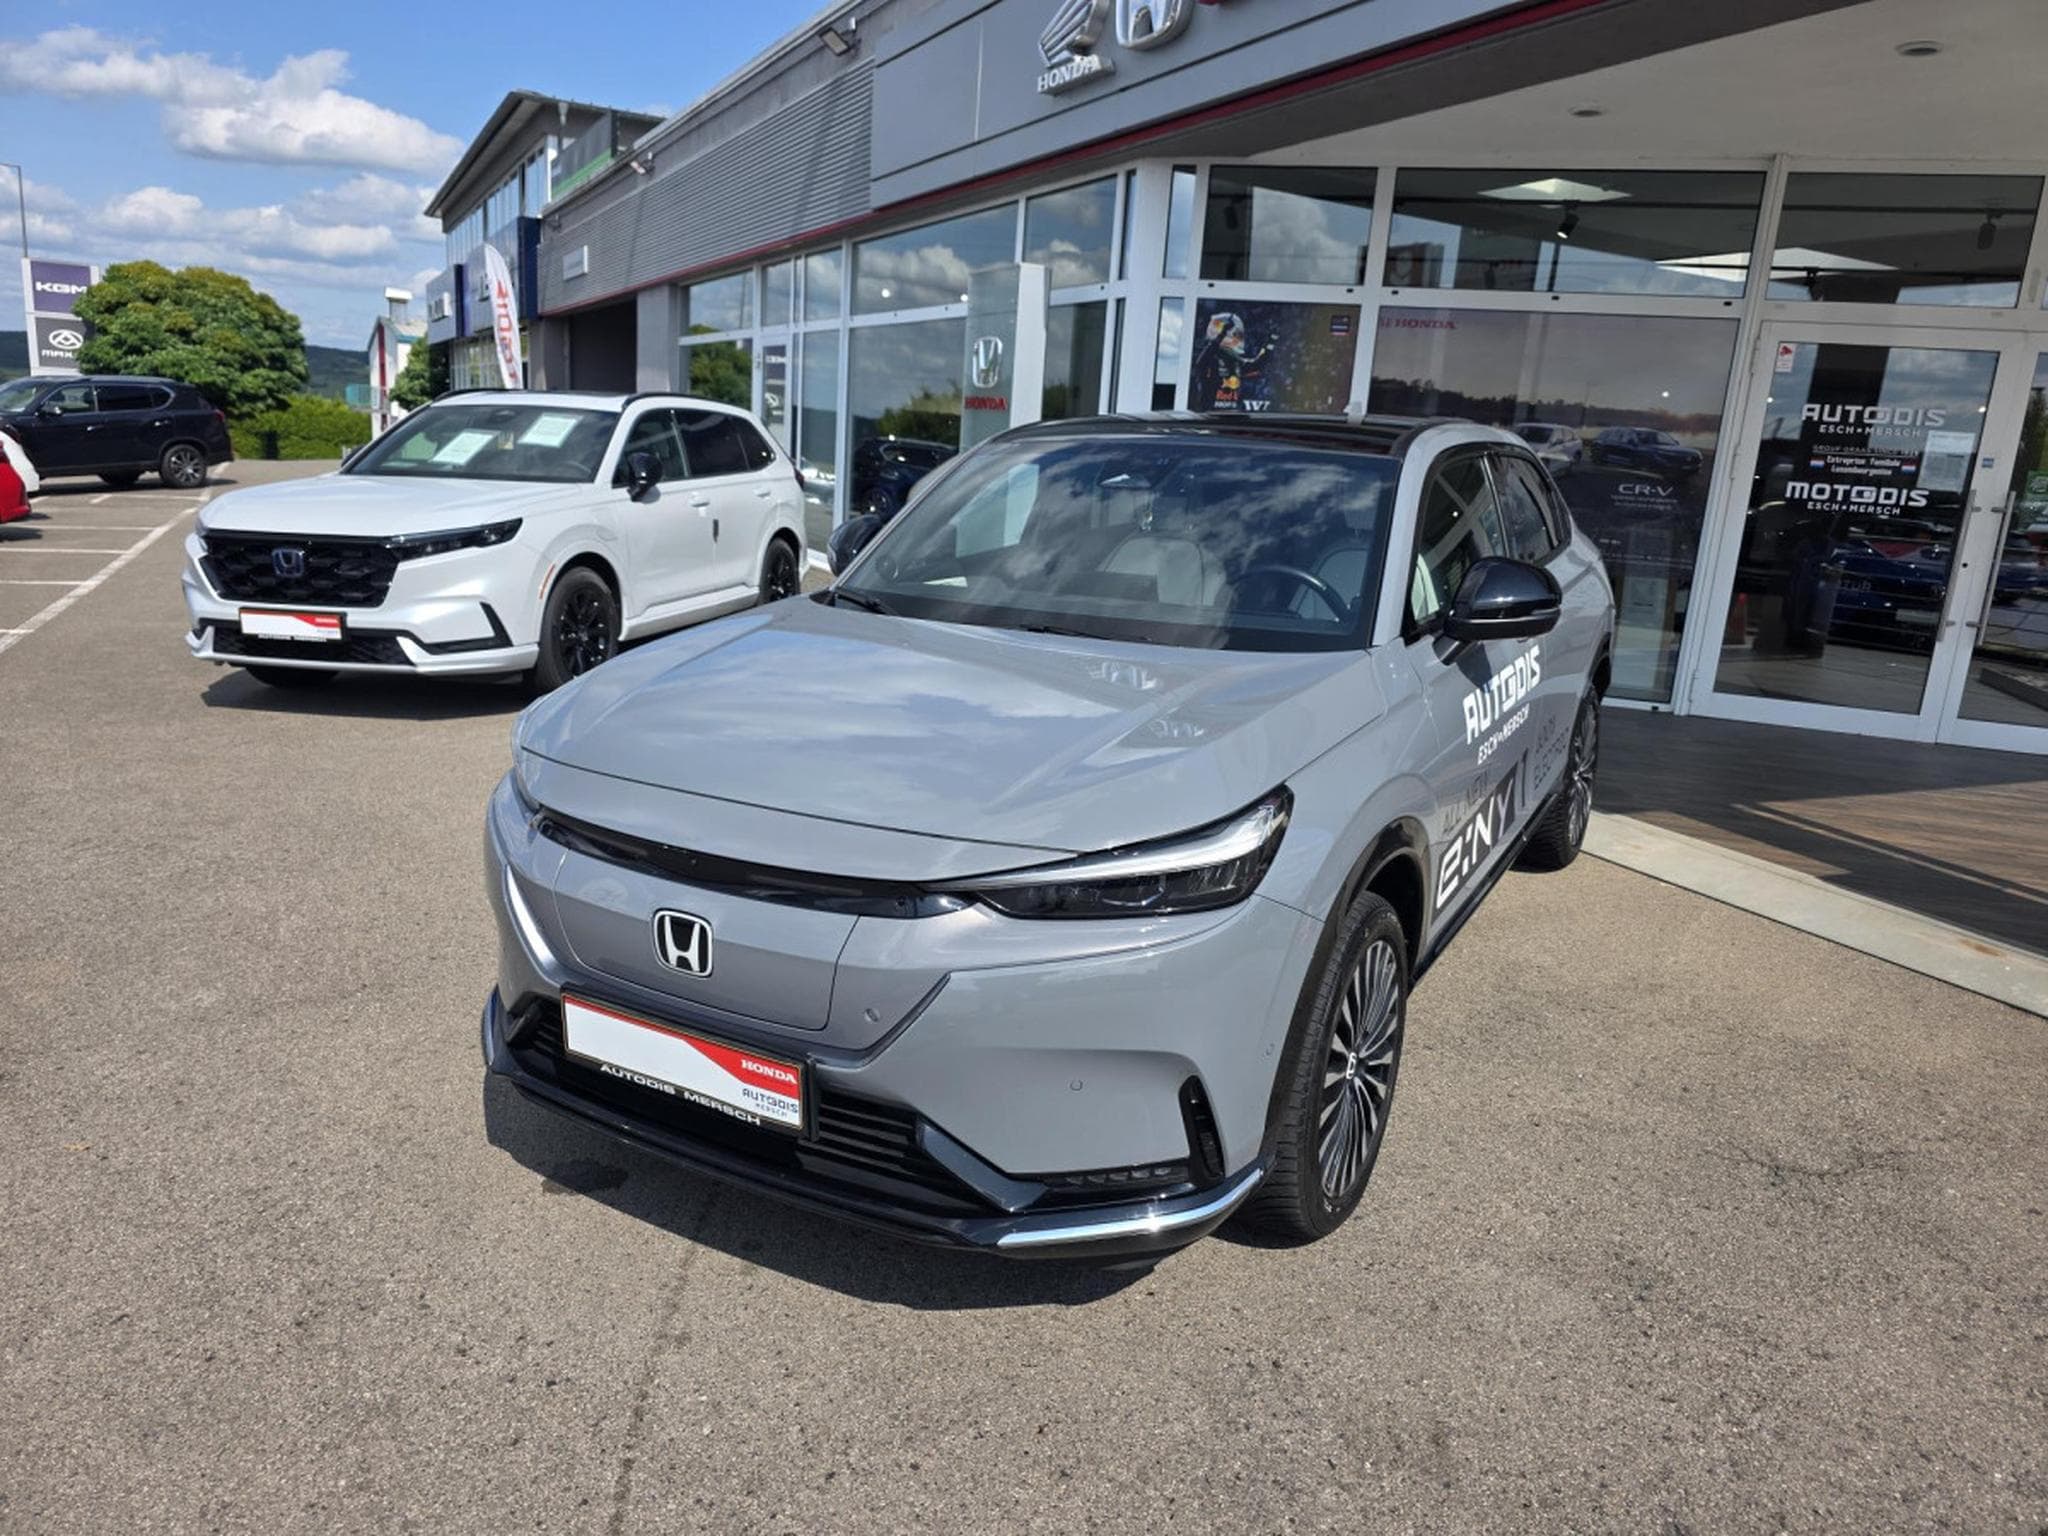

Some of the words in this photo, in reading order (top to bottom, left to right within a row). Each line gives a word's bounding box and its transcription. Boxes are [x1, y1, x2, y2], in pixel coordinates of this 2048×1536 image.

[1037, 55, 1102, 93] HONDA
[35, 282, 88, 295] KGM
[964, 396, 1008, 411] HONDA
[1802, 403, 1947, 427] AUTODIS
[1785, 481, 1930, 507] MOTODIS
[1463, 645, 1540, 744] AUTODIS
[741, 1059, 798, 1084] HONDA
[600, 1064, 675, 1095] AUTODIS
[684, 1090, 761, 1126] MERSCH
[742, 1088, 798, 1113] AUTODIS
